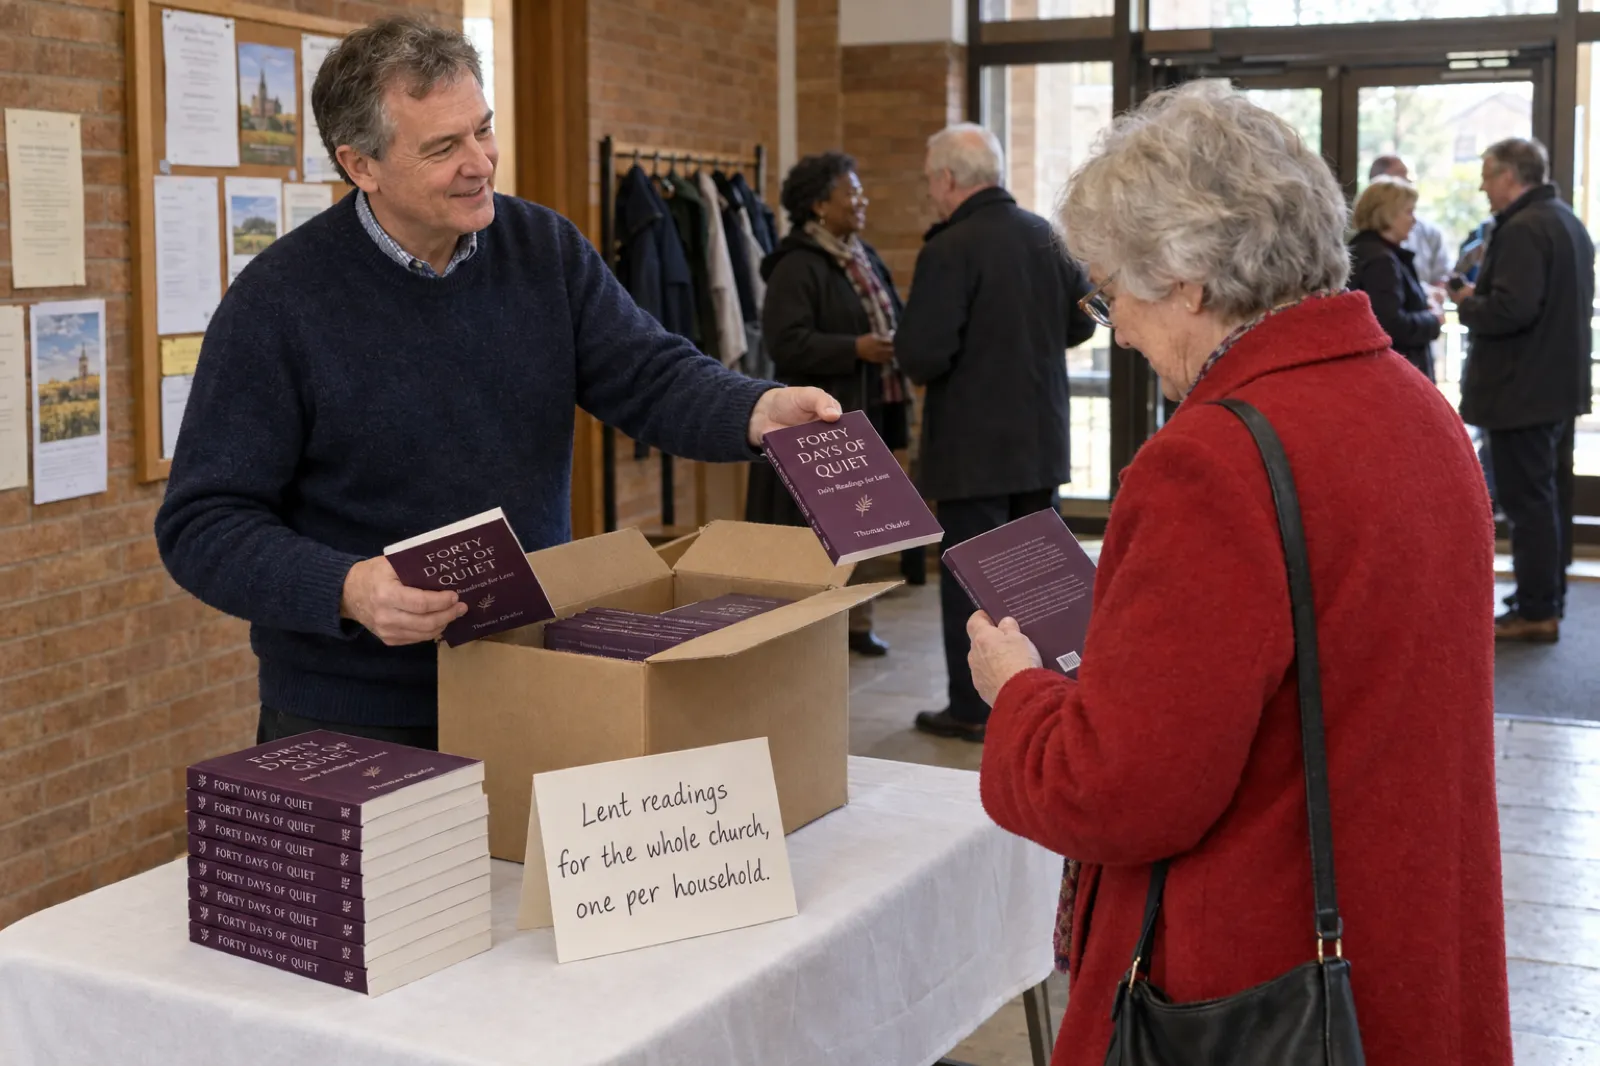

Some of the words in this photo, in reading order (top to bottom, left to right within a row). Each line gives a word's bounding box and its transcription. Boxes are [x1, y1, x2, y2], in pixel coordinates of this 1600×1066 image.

[797, 428, 849, 448] FORTY
[798, 444, 842, 464] DAYS
[845, 439, 866, 452] OF
[816, 455, 869, 478] QUIET
[818, 487, 834, 495] Daily
[835, 480, 864, 490] Readings
[865, 476, 874, 484] for
[874, 473, 890, 481] Lent
[854, 526, 884, 538] Thomas
[884, 520, 910, 530] Okafor
[423, 555, 469, 577] DAYS
[473, 546, 496, 560] OF
[426, 537, 482, 562] FORTY
[438, 558, 496, 586] QUIET
[499, 572, 514, 580] Lent
[246, 740, 319, 763] FORTY
[258, 751, 318, 770] DAYS
[321, 742, 349, 752] OF
[292, 749, 359, 771] QUIET
[214, 780, 240, 794] FORTY
[244, 784, 267, 800] DAYS
[270, 793, 281, 803] OF
[285, 797, 313, 810] QUIET
[368, 778, 404, 790] Thomas
[214, 803, 242, 817] FORTY
[246, 810, 270, 823] DAYS
[273, 816, 284, 826] OF
[287, 820, 315, 833] QUIET
[582, 792, 632, 827] Lent
[642, 782, 728, 814] readings
[216, 825, 242, 839] FORTY
[245, 832, 267, 846] DAYS
[271, 839, 282, 848] OF
[285, 842, 314, 857] QUIET
[558, 849, 590, 878] for
[601, 842, 636, 869] the
[647, 826, 700, 858] whole
[708, 813, 770, 846] church,
[216, 847, 242, 862] FORTY
[246, 855, 268, 868] DAYS
[272, 862, 283, 871] OF
[287, 866, 315, 880] QUIET
[216, 869, 244, 884] FORTY
[248, 877, 270, 891] DAYS
[274, 885, 285, 895] OF
[289, 889, 317, 903] QUIET
[576, 896, 616, 919] one
[626, 885, 659, 916] per
[673, 858, 770, 898] household.
[217, 891, 244, 907] FORTY
[248, 900, 271, 914] DAYS
[274, 908, 285, 917] OF
[289, 911, 318, 927] QUIET
[218, 913, 246, 930] FORTY
[250, 923, 272, 937] DAYS
[276, 930, 287, 940] OF
[290, 935, 318, 950] QUIET
[218, 935, 246, 951] FORTY
[250, 945, 273, 959] DAYS
[276, 953, 287, 963] OF
[291, 957, 318, 972] QUIET
